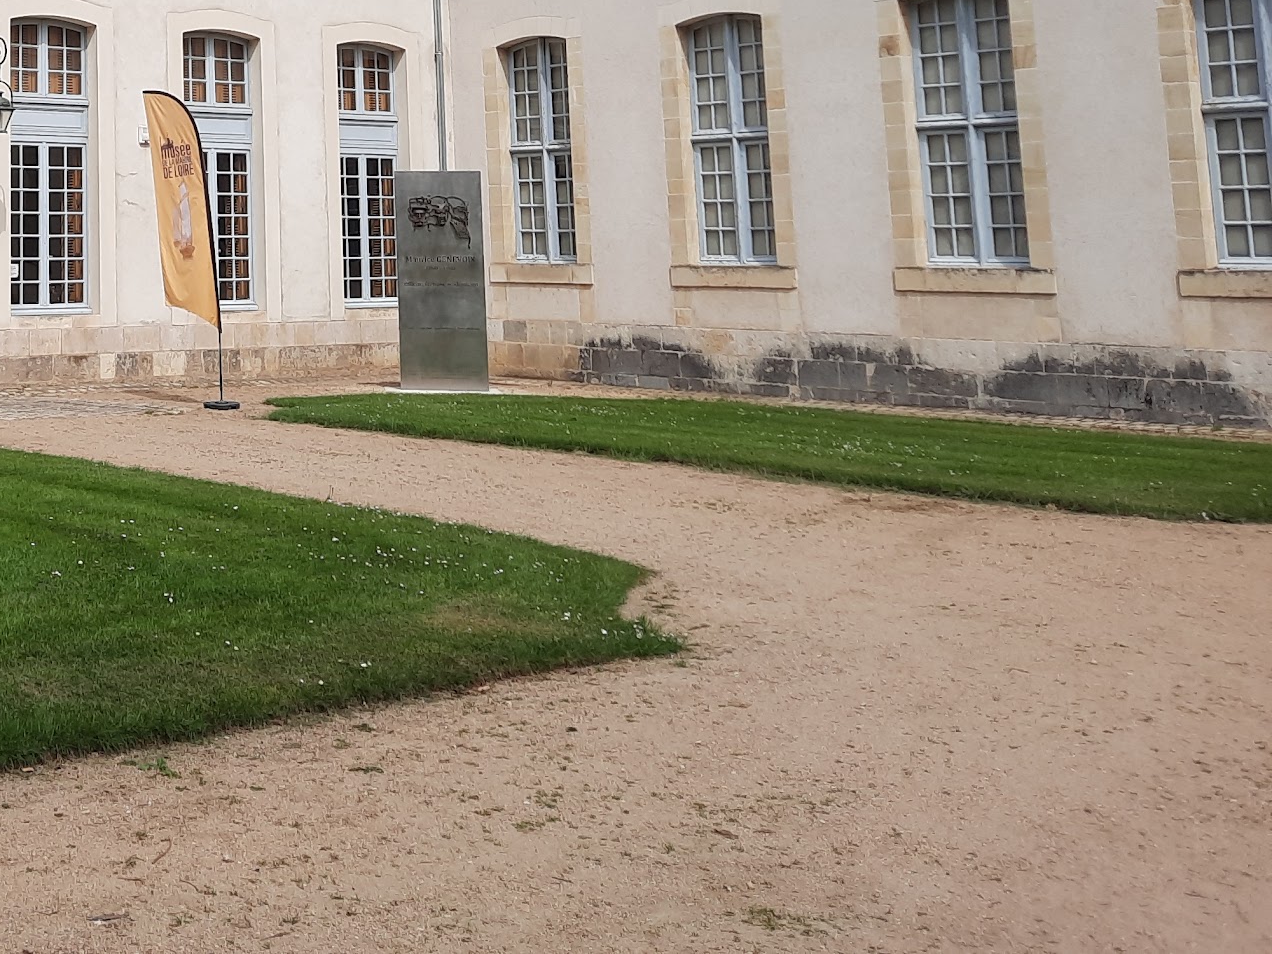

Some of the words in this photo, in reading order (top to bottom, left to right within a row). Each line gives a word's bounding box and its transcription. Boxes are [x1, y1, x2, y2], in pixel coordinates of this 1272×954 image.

[160, 139, 192, 159] musée
[163, 167, 173, 179] DE
[174, 163, 194, 177] LOIRE
